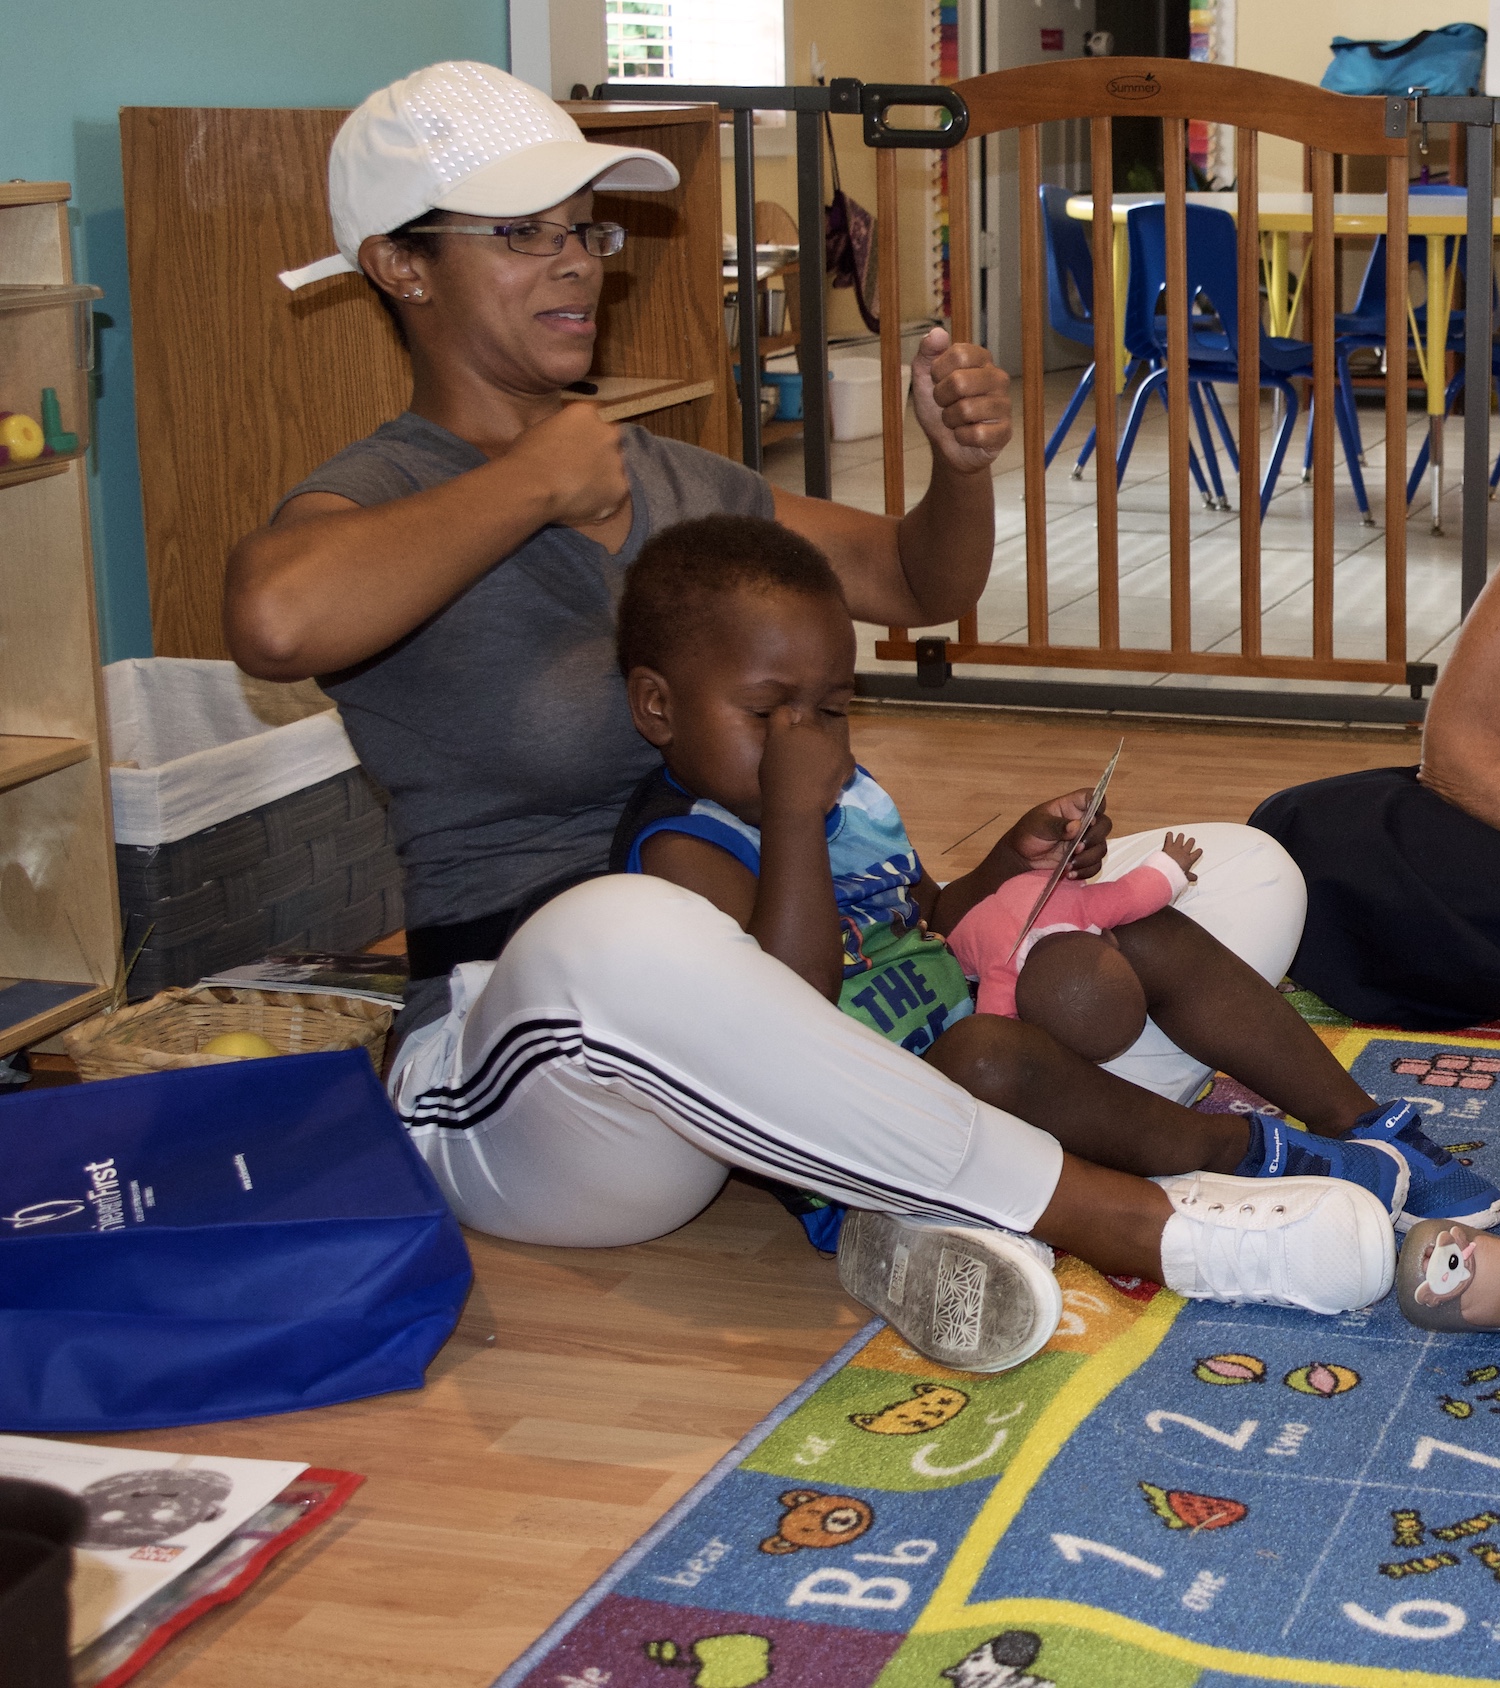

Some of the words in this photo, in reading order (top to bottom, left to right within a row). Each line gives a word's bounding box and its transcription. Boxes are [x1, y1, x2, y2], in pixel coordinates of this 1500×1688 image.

[1110, 81, 1155, 93] Summer
[851, 959, 938, 1034] THE
[1269, 1127, 1283, 1174] Champion
[1145, 1409, 1259, 1451] 2
[1265, 1422, 1310, 1456] two
[653, 1536, 734, 1589] bear
[787, 1539, 939, 1611] Bb
[1051, 1533, 1165, 1580] 1
[1182, 1570, 1227, 1612] one
[1342, 1600, 1467, 1640] 6
